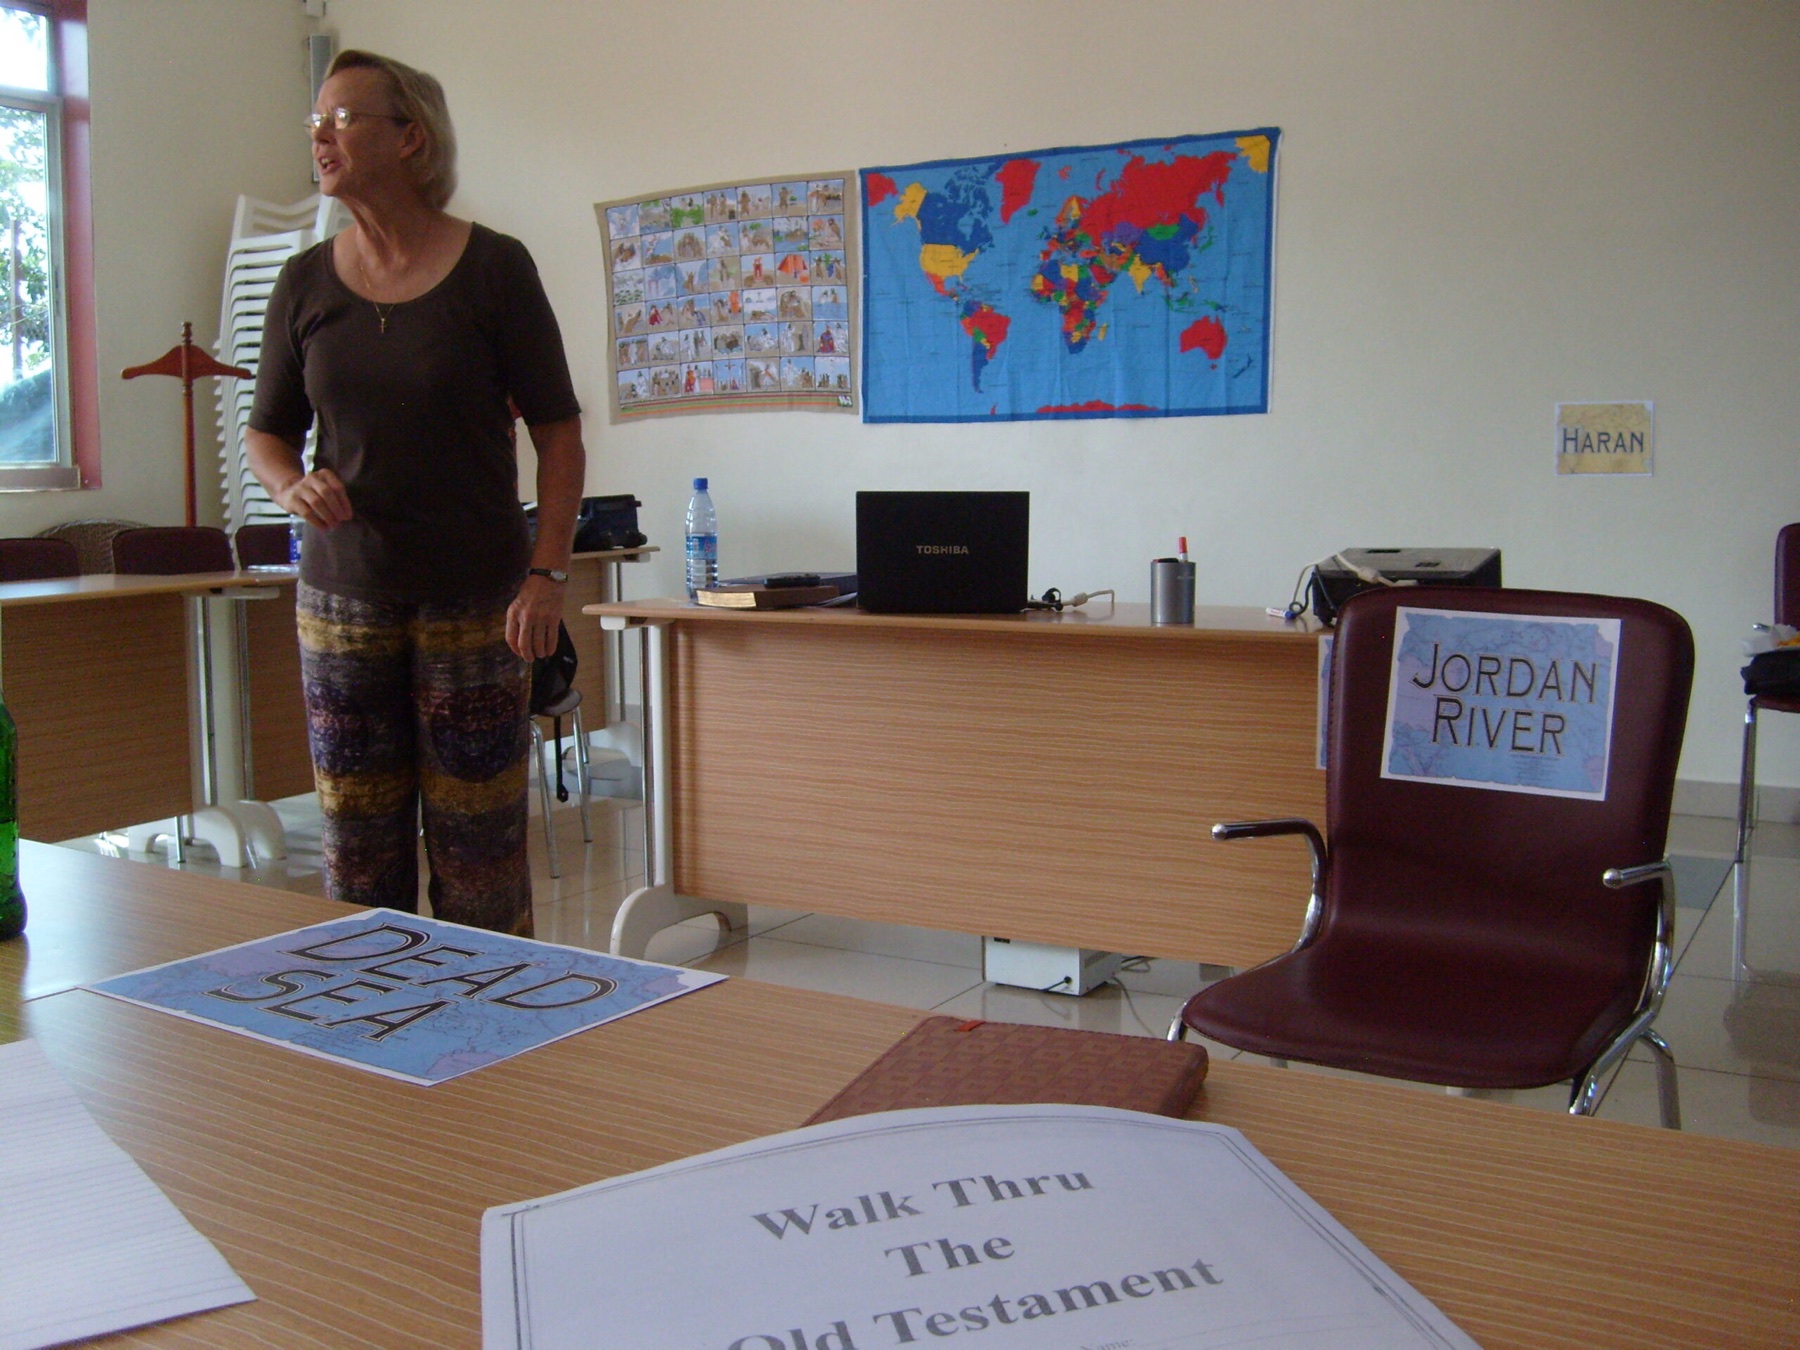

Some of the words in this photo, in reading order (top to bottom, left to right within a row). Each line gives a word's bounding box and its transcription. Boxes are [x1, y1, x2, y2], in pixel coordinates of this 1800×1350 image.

[1562, 427, 1645, 453] HARAN
[916, 545, 969, 554] TOSHIBA
[1411, 643, 1597, 703] JORDAN
[1431, 696, 1566, 755] RIVER
[278, 922, 619, 1009] DEAD
[202, 968, 458, 1042] SEA
[750, 1190, 924, 1241] Walk
[932, 1170, 1095, 1209] Thru
[884, 1235, 1016, 1278] The
[872, 1257, 1225, 1344] Testament
